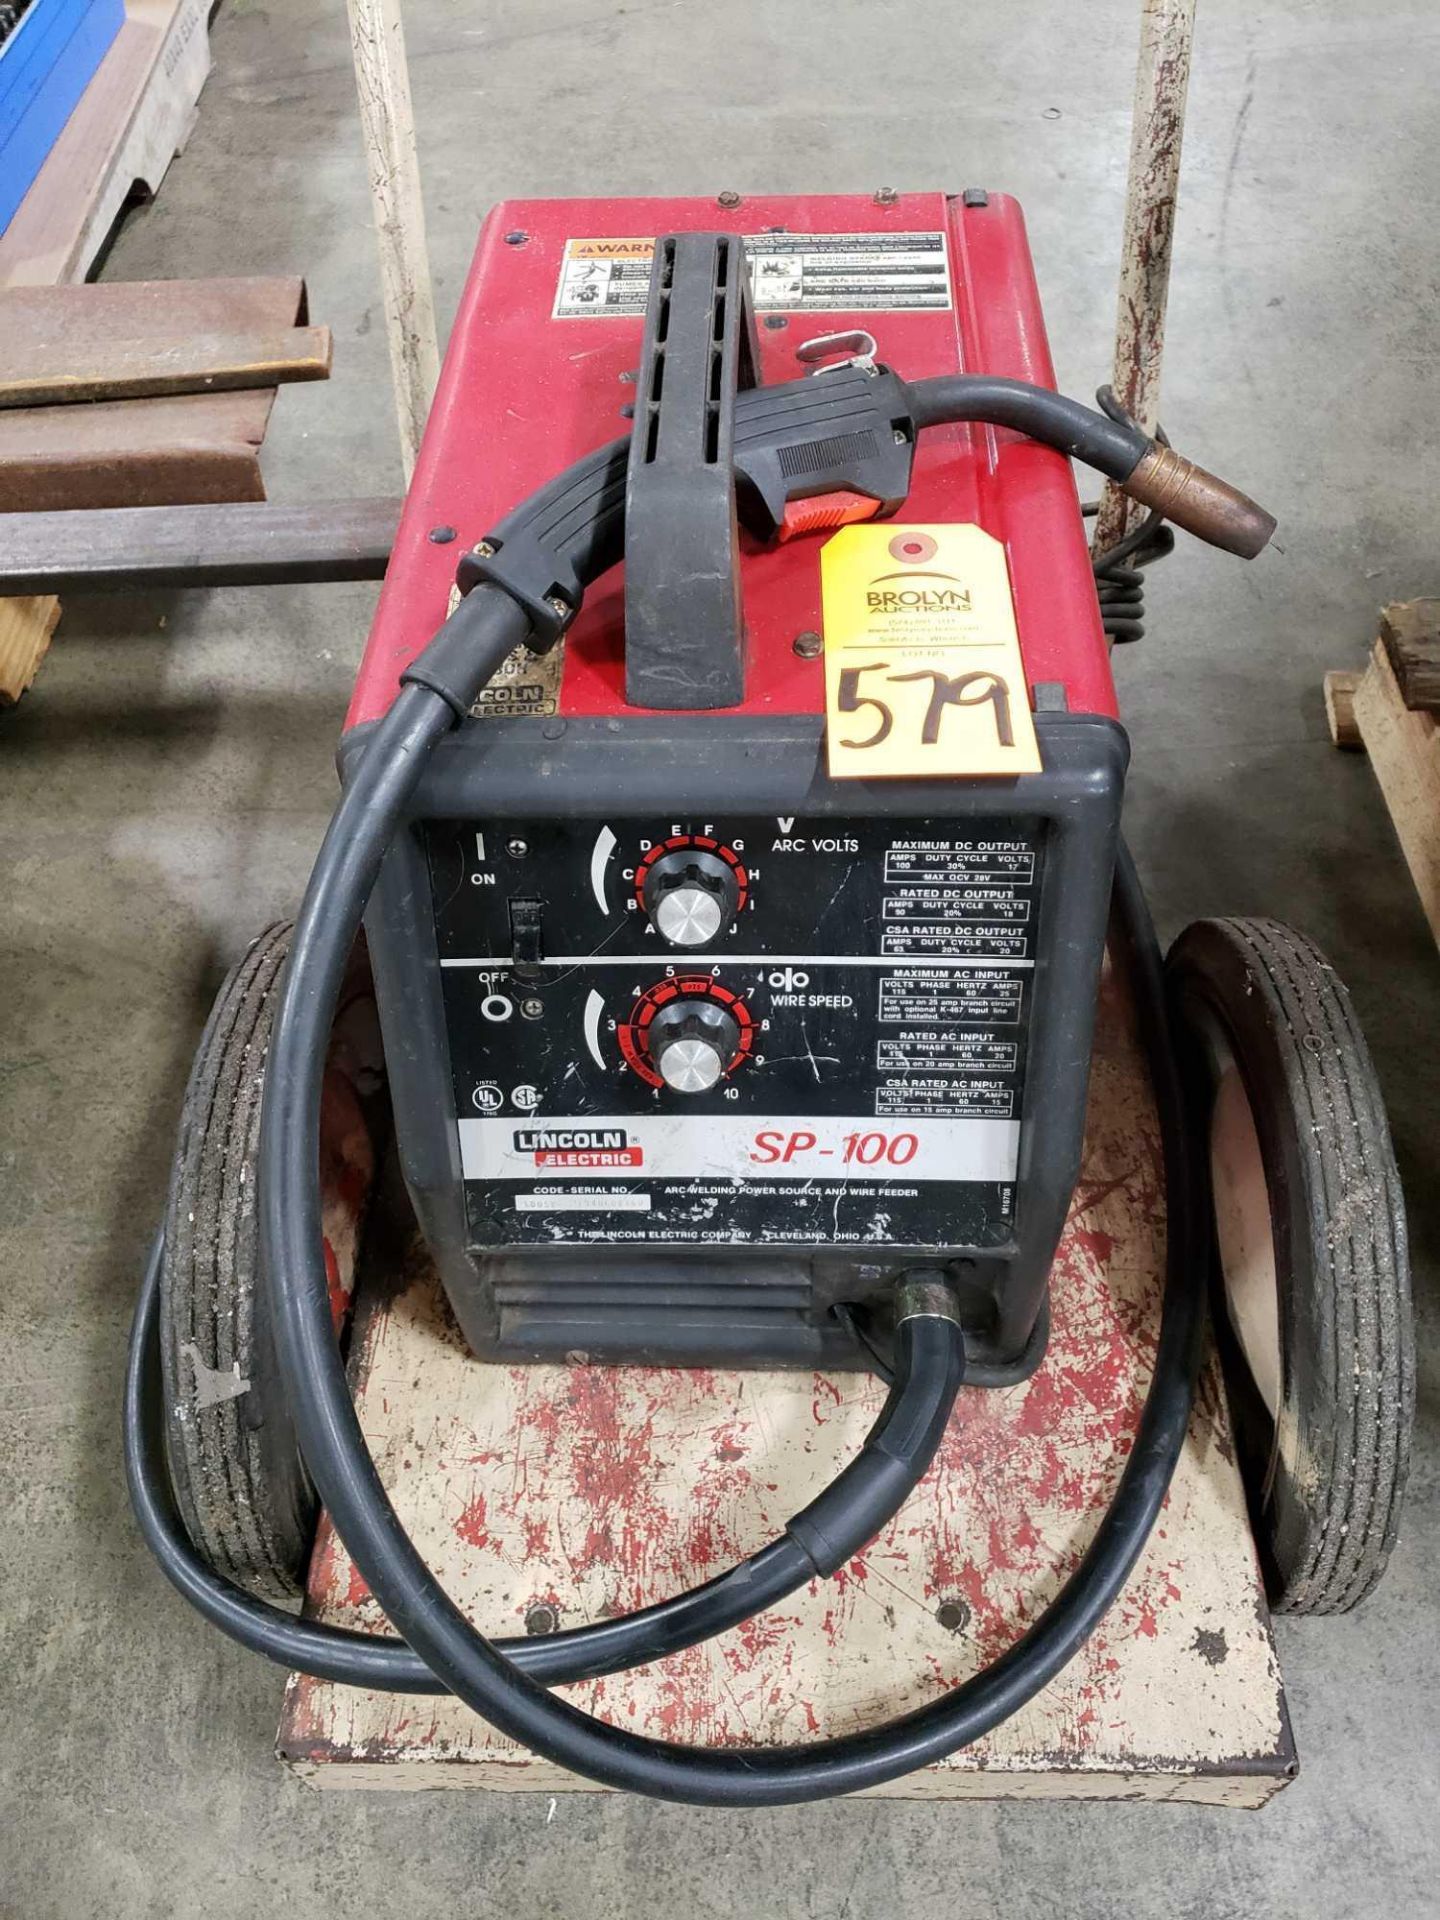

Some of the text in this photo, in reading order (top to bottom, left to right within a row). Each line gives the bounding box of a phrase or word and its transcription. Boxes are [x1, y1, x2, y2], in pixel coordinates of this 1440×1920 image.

[867, 590, 970, 606] BROLYN
[870, 605, 972, 613] AUCTIONS
[477, 687, 539, 702] COLN
[838, 662, 1016, 748] 579
[704, 825, 713, 835] F
[777, 817, 794, 833] V
[672, 826, 682, 835] E
[640, 840, 650, 850] D
[733, 840, 744, 850] G
[772, 840, 858, 852] ARC VOLTS
[892, 841, 1027, 850] MAXIMUM DC OUTPUT
[471, 874, 496, 885] ON
[623, 869, 634, 880] C
[749, 870, 760, 880] H
[964, 890, 1013, 898] OUTPUT
[627, 900, 637, 909] B
[645, 924, 655, 934] A
[730, 924, 737, 934] J
[886, 926, 1024, 936] CSA RATED DC OUTPUT
[666, 965, 674, 976] 5
[712, 965, 720, 976] 6
[894, 970, 1010, 979] MAXIMUM AC INPUT
[479, 972, 508, 983] OFF
[632, 986, 641, 996] 4
[746, 988, 754, 998] 7
[771, 995, 852, 1007] WIRE SPEED
[608, 1020, 616, 1030] 3
[762, 1020, 769, 1030] 8
[756, 1055, 764, 1065] 9
[619, 1061, 627, 1071] 2
[886, 1079, 908, 1087] CSA
[952, 1080, 967, 1088] AC
[652, 1089, 659, 1098] 1
[724, 1088, 738, 1099] 10
[519, 1133, 621, 1148] LINCOLN
[750, 1131, 919, 1164] SP-100
[547, 1154, 632, 1166] ELECTRIC
[665, 1186, 687, 1194] ARC
[690, 1186, 734, 1194] WELDING
[739, 1187, 776, 1195] POWER
[779, 1187, 821, 1195] SOURCE
[850, 1188, 875, 1196] WIRE
[878, 1189, 918, 1197] FEEDER
[600, 1231, 645, 1239] LINCOLN
[649, 1231, 698, 1239] ELECTRIC
